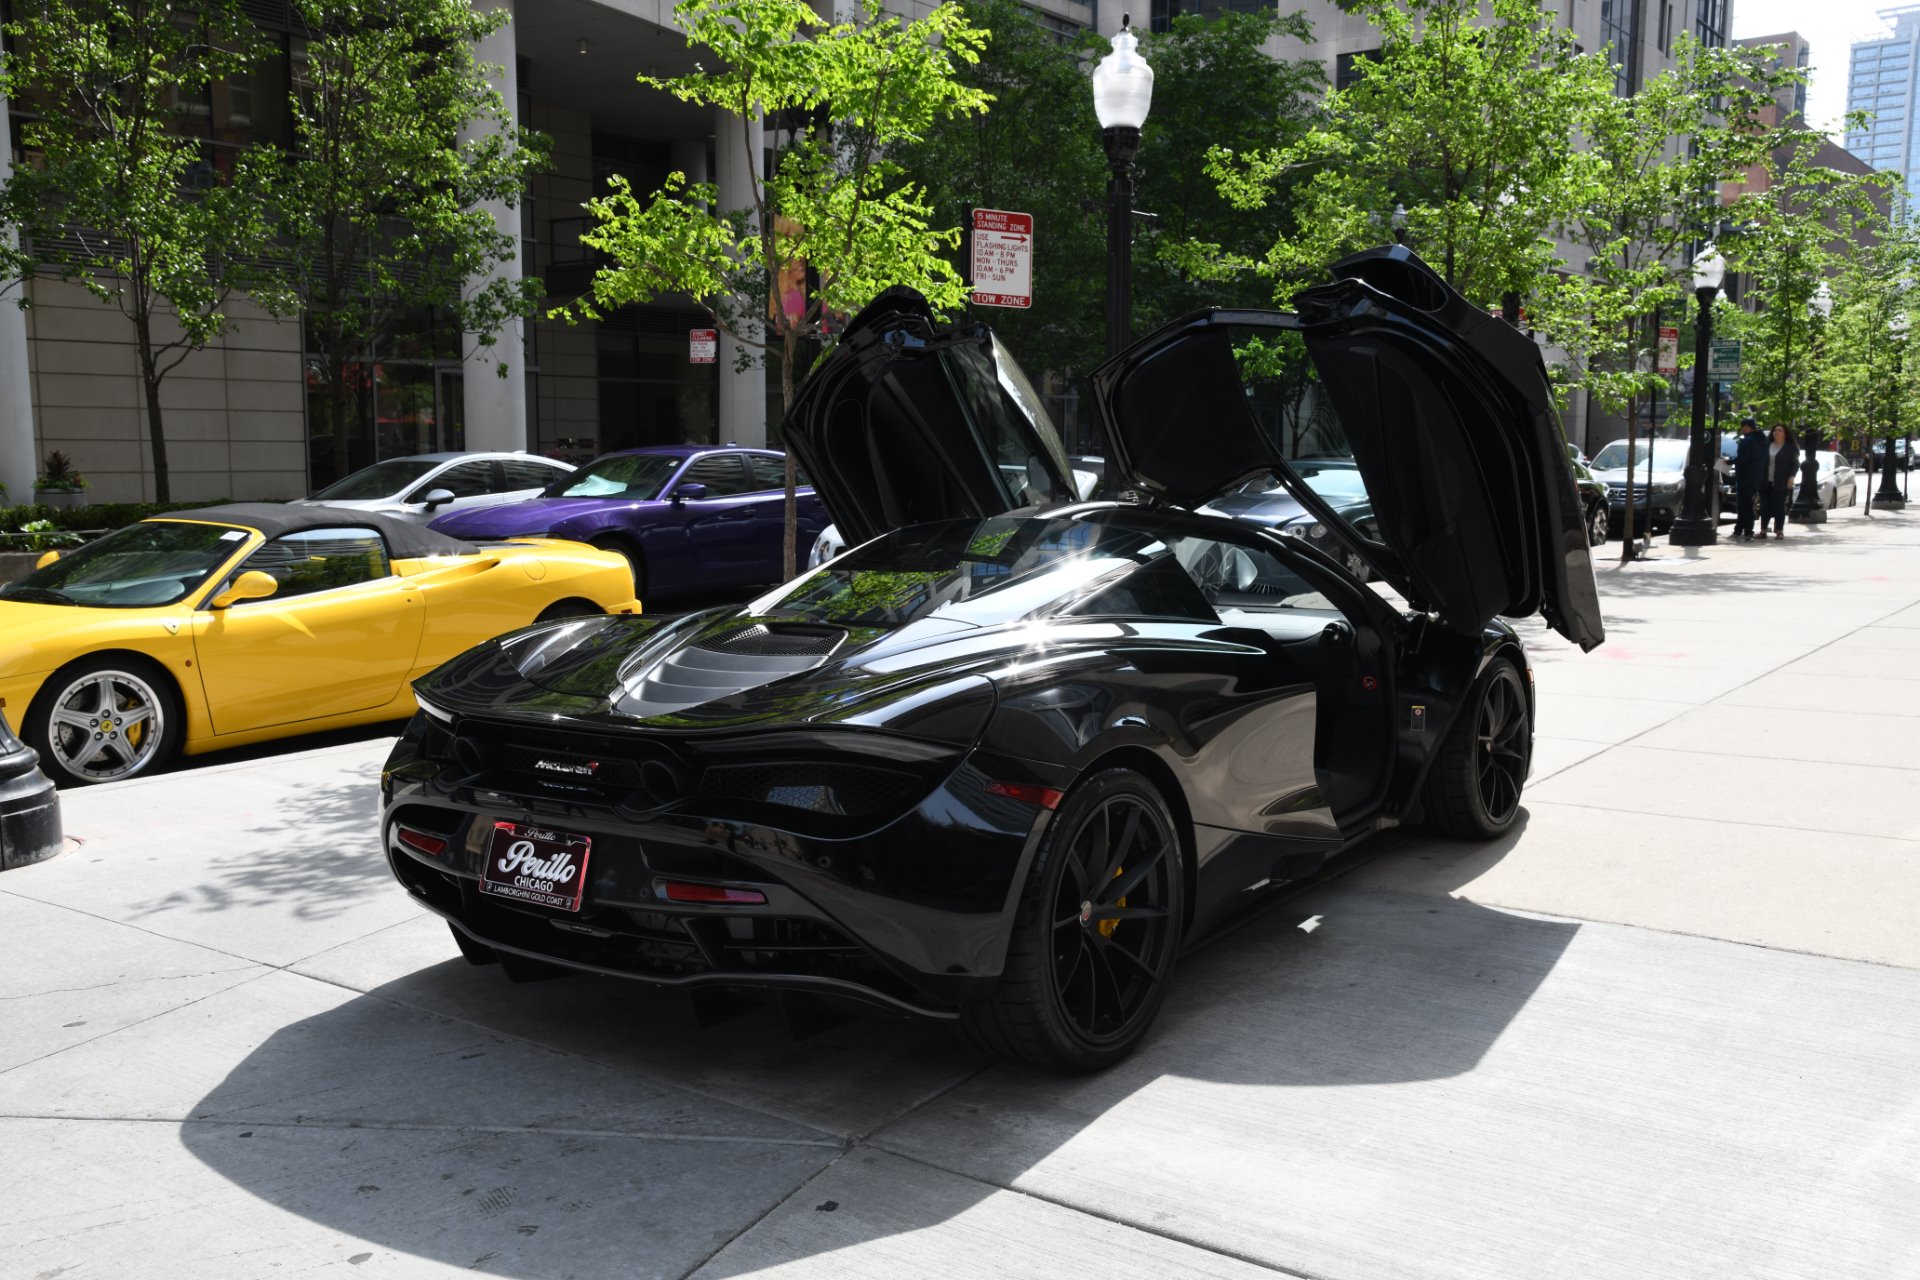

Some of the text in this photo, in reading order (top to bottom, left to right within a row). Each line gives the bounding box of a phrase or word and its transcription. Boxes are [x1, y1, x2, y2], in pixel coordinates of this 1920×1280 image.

[985, 213, 1008, 222] MINUTE
[977, 221, 1026, 232] STANDING ZONE
[976, 241, 1028, 253] FLASHING LIGHTS
[976, 272, 987, 280] FRI
[976, 294, 1026, 306] TOW ZONE
[524, 828, 556, 841] Perillo
[497, 840, 576, 884] Perillo
[514, 875, 554, 892] CHICAGO
[493, 885, 563, 906] LAMBORGHINI GOLD COAST
